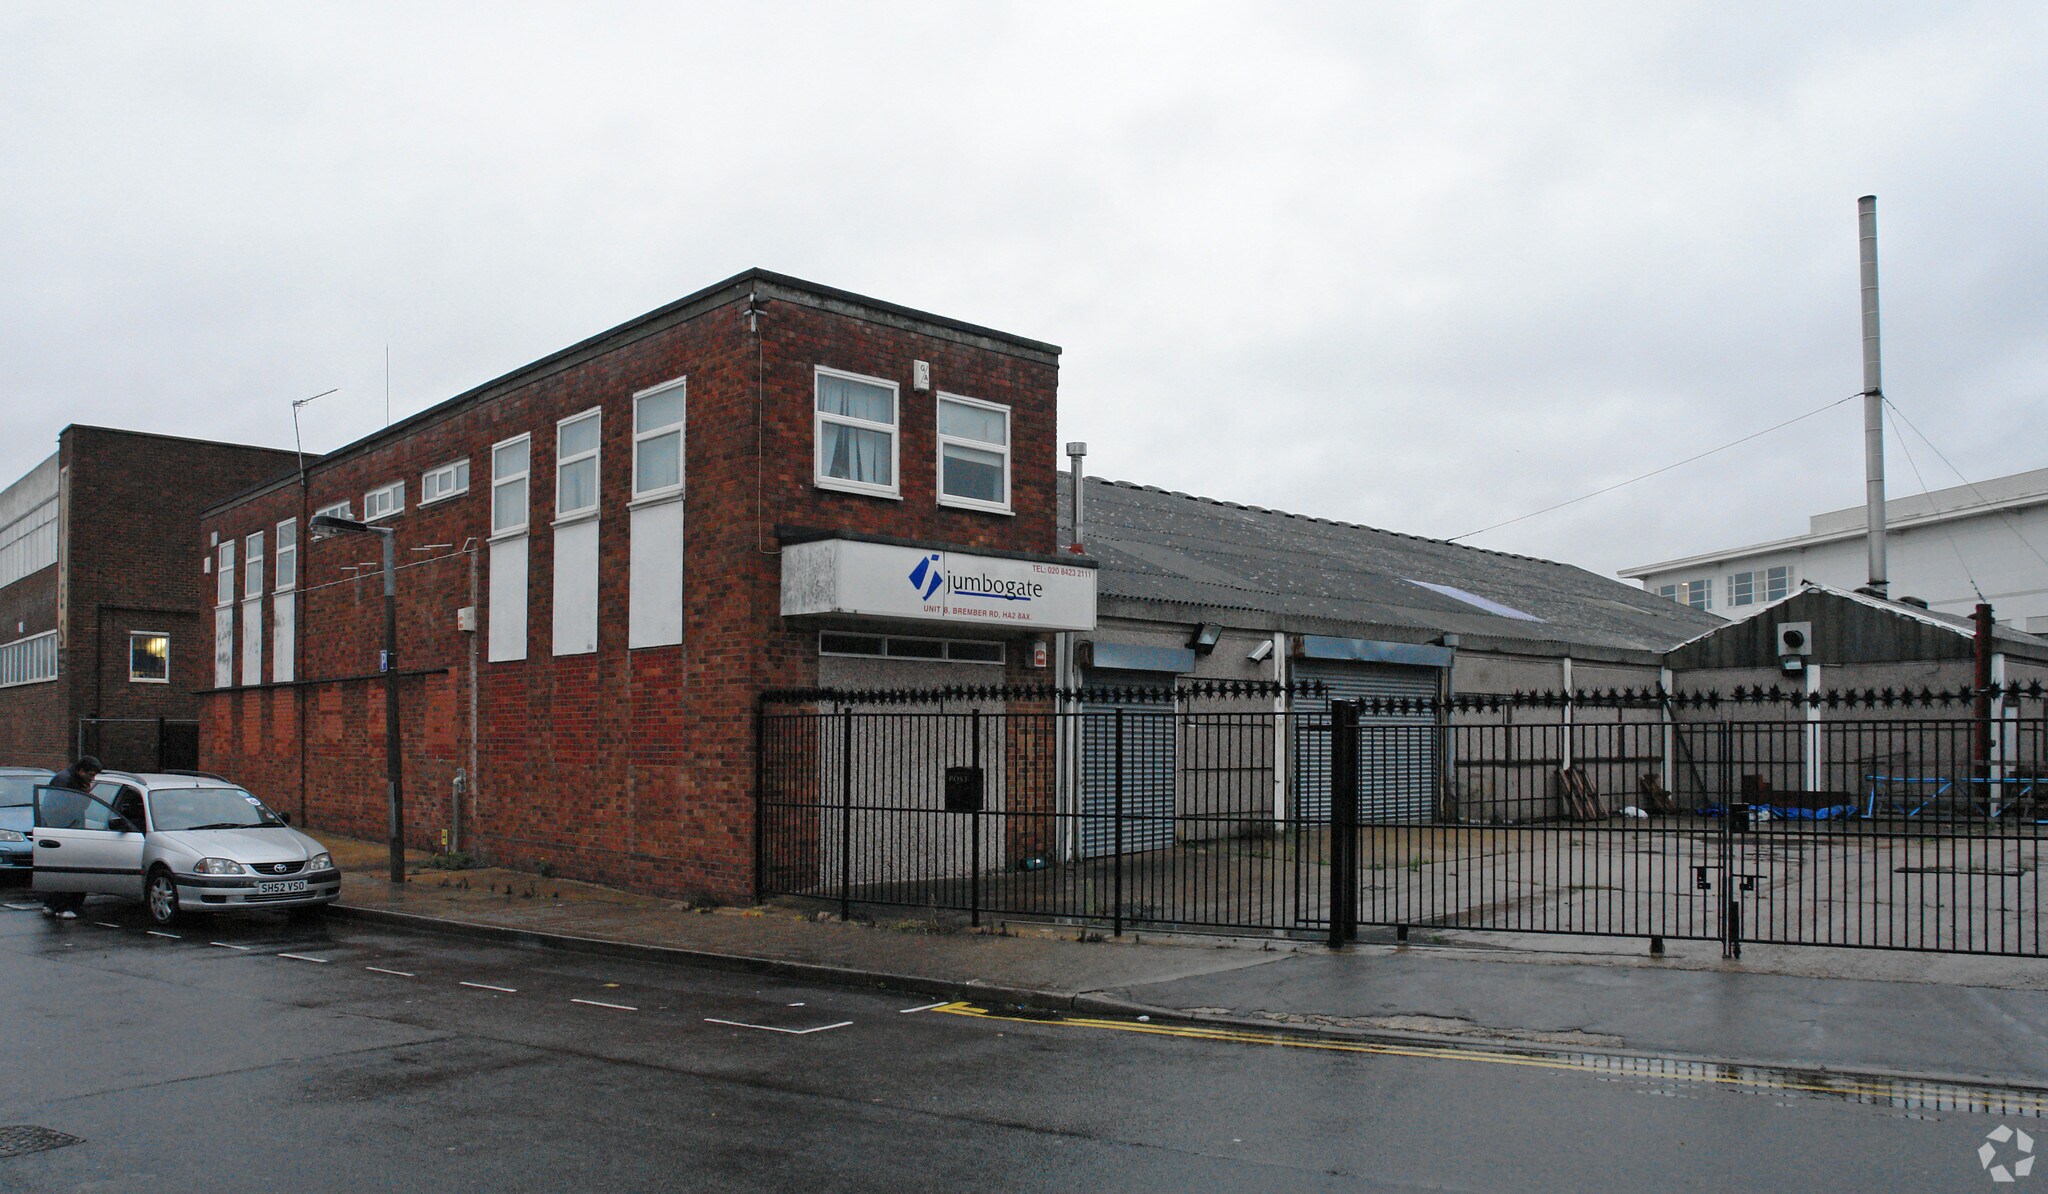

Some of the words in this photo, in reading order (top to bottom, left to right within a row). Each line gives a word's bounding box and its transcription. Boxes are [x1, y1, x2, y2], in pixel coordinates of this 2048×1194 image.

[1032, 564, 1047, 574] TEL:
[1047, 566, 1060, 575] 020
[1060, 567, 1076, 577] 8423
[1077, 569, 1091, 578] 2111
[946, 570, 1043, 601] jumbogate
[923, 604, 941, 613] UNIT
[952, 607, 987, 617] BREMBER
[1002, 611, 1016, 619] HA2
[261, 883, 286, 893] SH52
